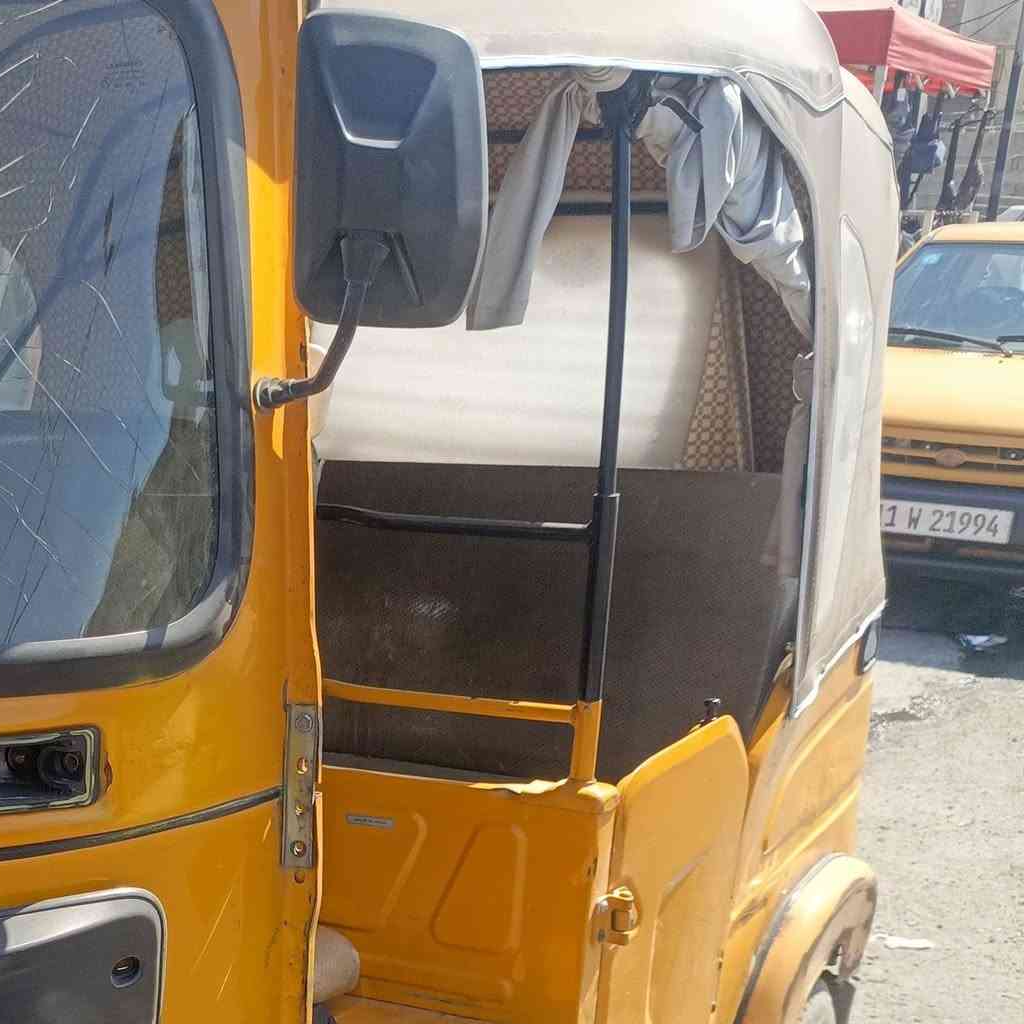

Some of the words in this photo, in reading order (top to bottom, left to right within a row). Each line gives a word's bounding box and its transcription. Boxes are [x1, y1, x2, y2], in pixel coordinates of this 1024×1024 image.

[880, 504, 897, 527] 1
[907, 506, 922, 530] W
[929, 509, 999, 538] 21994
